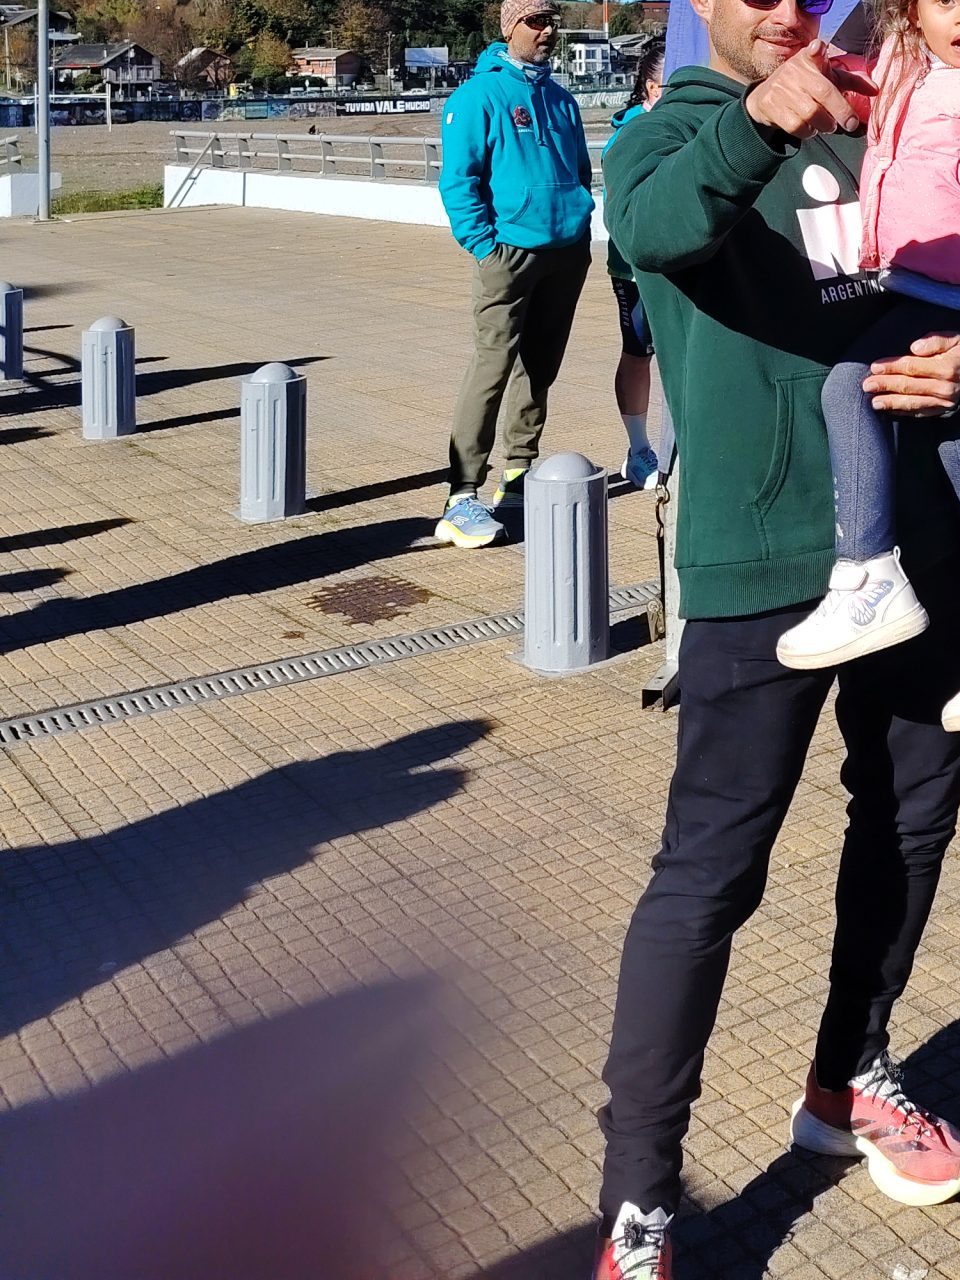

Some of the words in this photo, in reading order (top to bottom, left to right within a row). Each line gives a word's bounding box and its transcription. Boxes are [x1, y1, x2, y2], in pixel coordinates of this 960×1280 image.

[375, 100, 405, 113] VALE
[405, 100, 430, 111] MUCHO
[821, 279, 885, 304] ARGENTIN
